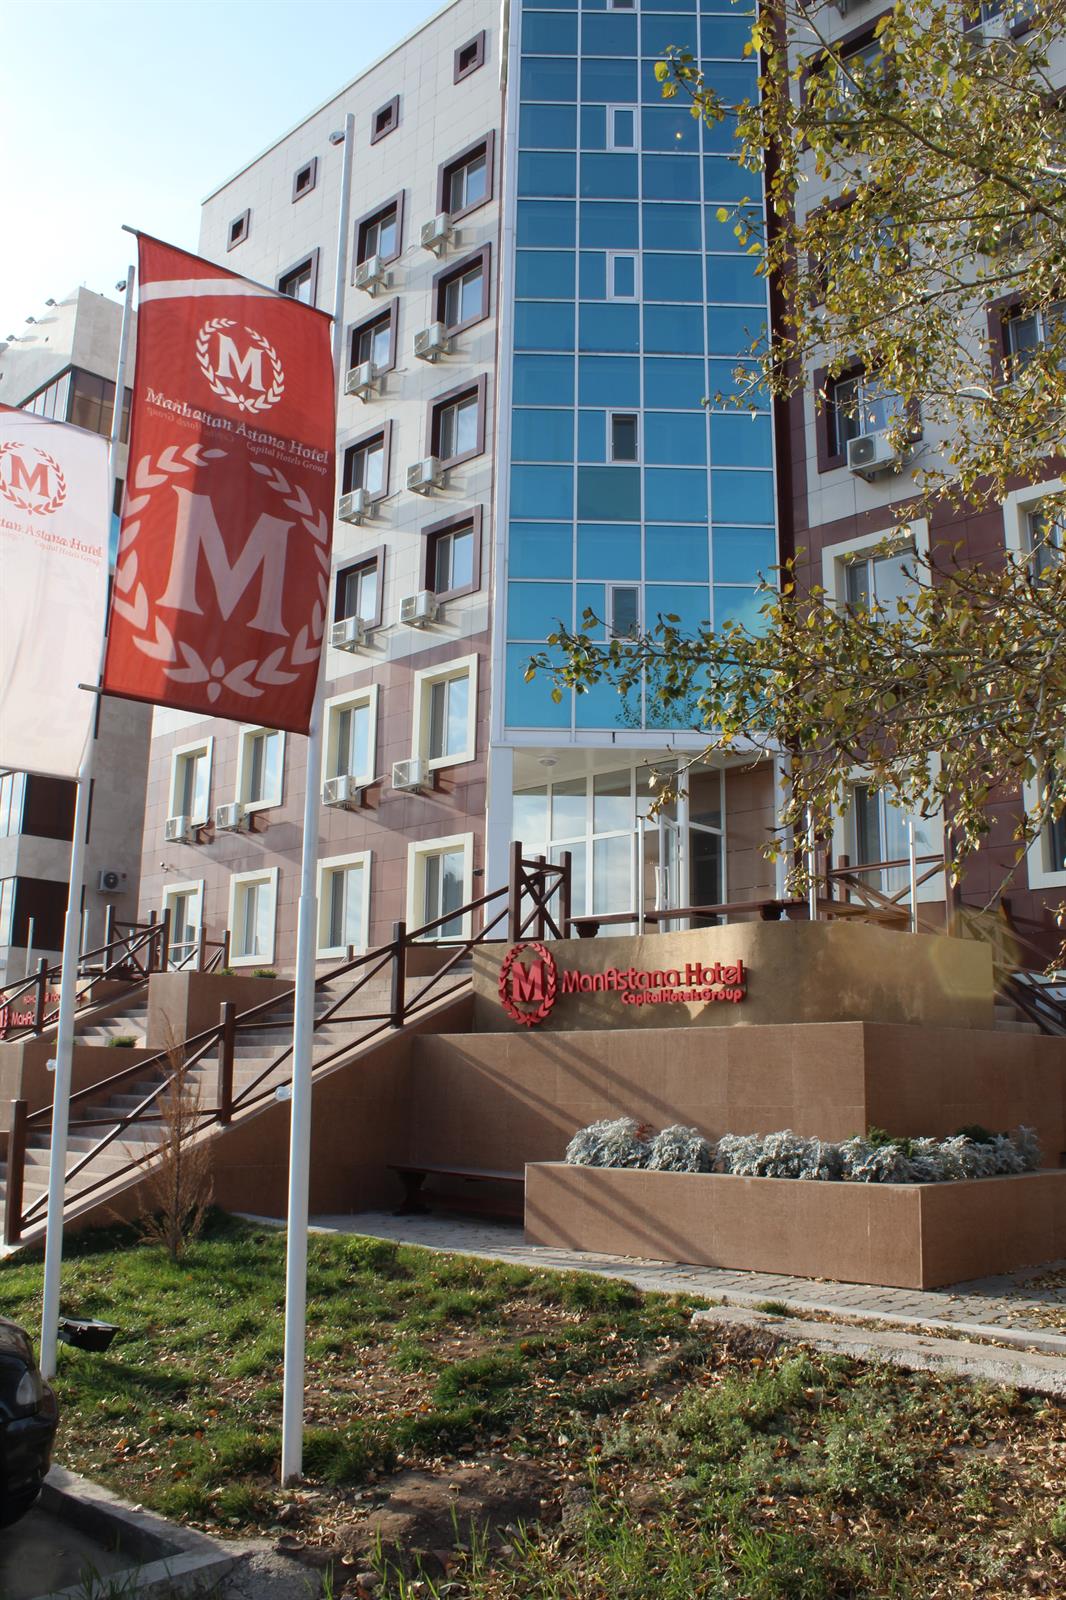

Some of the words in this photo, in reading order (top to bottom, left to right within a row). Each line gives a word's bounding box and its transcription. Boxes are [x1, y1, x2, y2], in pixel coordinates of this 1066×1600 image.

[215, 332, 265, 393] M
[144, 386, 232, 431] Manhattan
[235, 422, 285, 450] Astana
[289, 440, 329, 464] Hotel
[8, 452, 52, 500] M
[246, 441, 275, 457] Capital
[275, 450, 301, 466] Hotels
[302, 460, 328, 476] Group
[70, 537, 104, 558] Hotel
[155, 484, 297, 638] M
[511, 958, 546, 1002] M
[684, 958, 745, 988] Hotel
